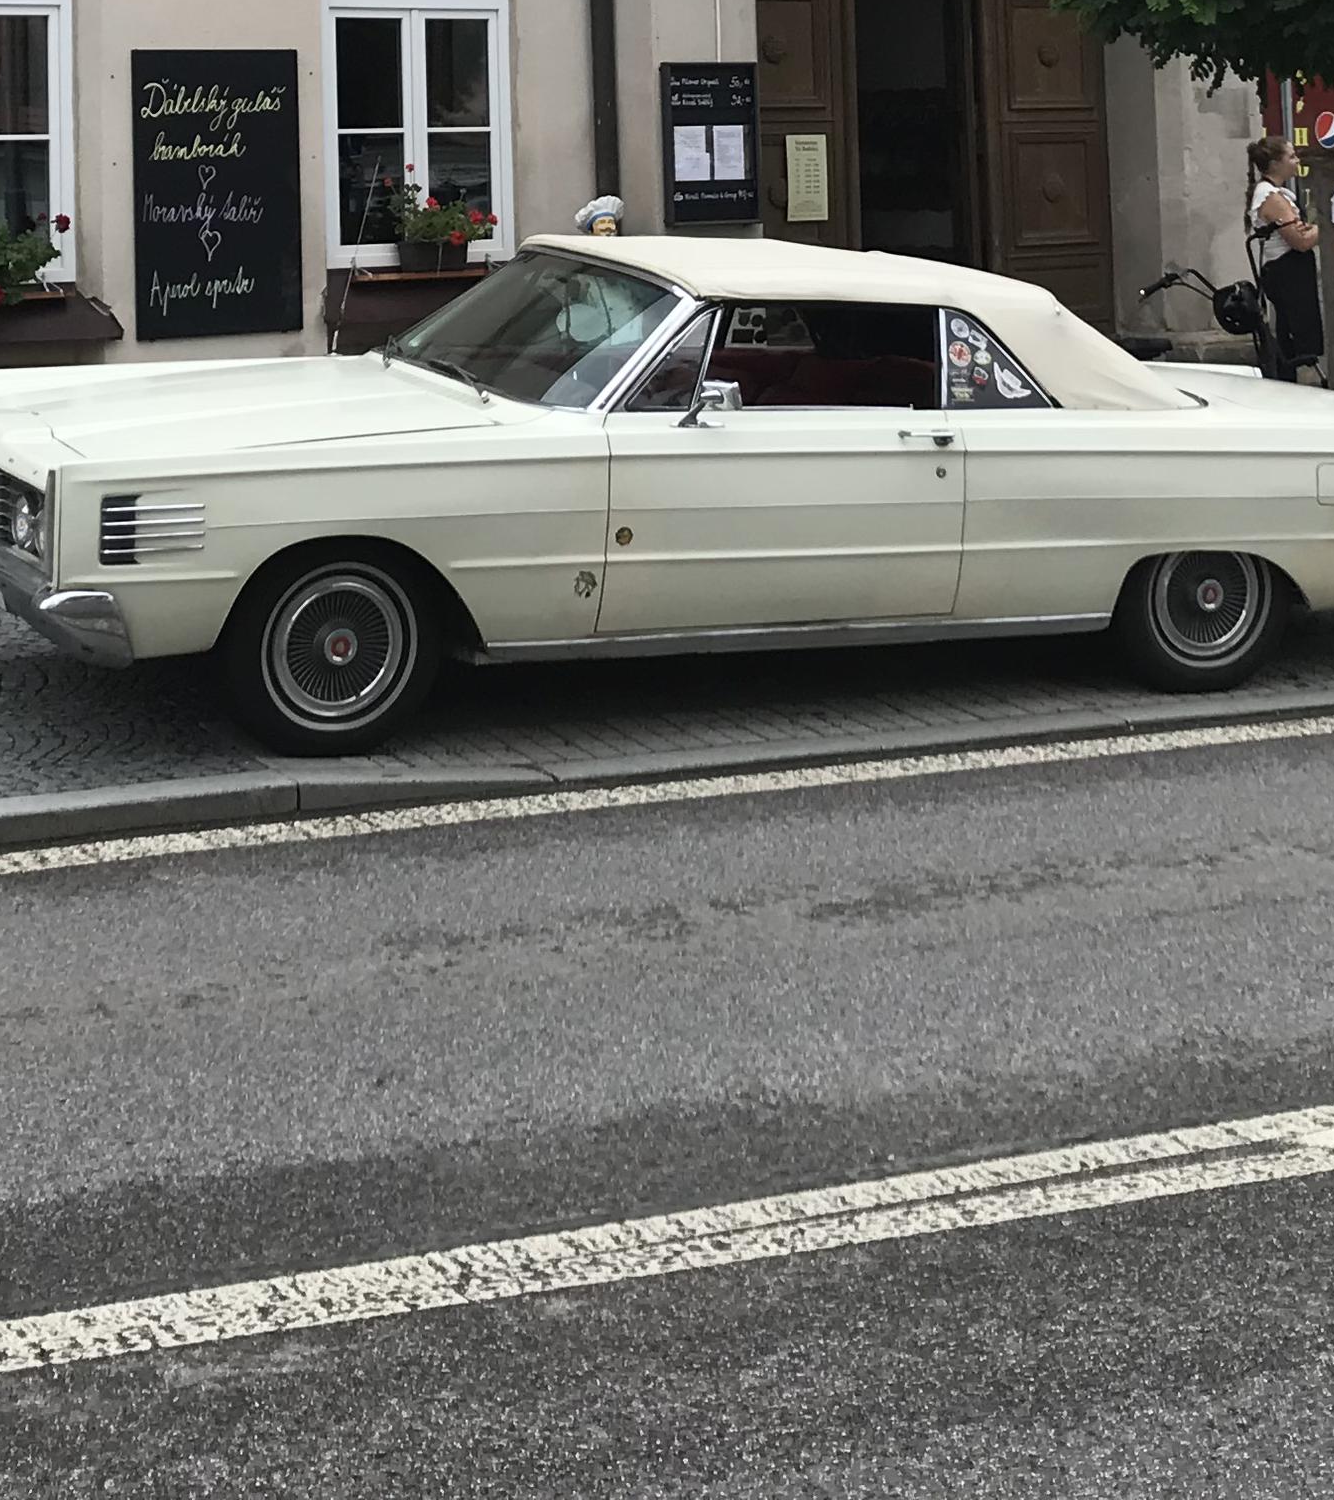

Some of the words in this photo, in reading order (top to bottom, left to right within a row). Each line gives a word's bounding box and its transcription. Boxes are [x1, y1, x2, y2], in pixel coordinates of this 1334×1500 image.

[226, 85, 287, 131] guláš
[142, 190, 217, 238] Moravský
[217, 190, 265, 225] talíř
[149, 269, 201, 317] Aperol
